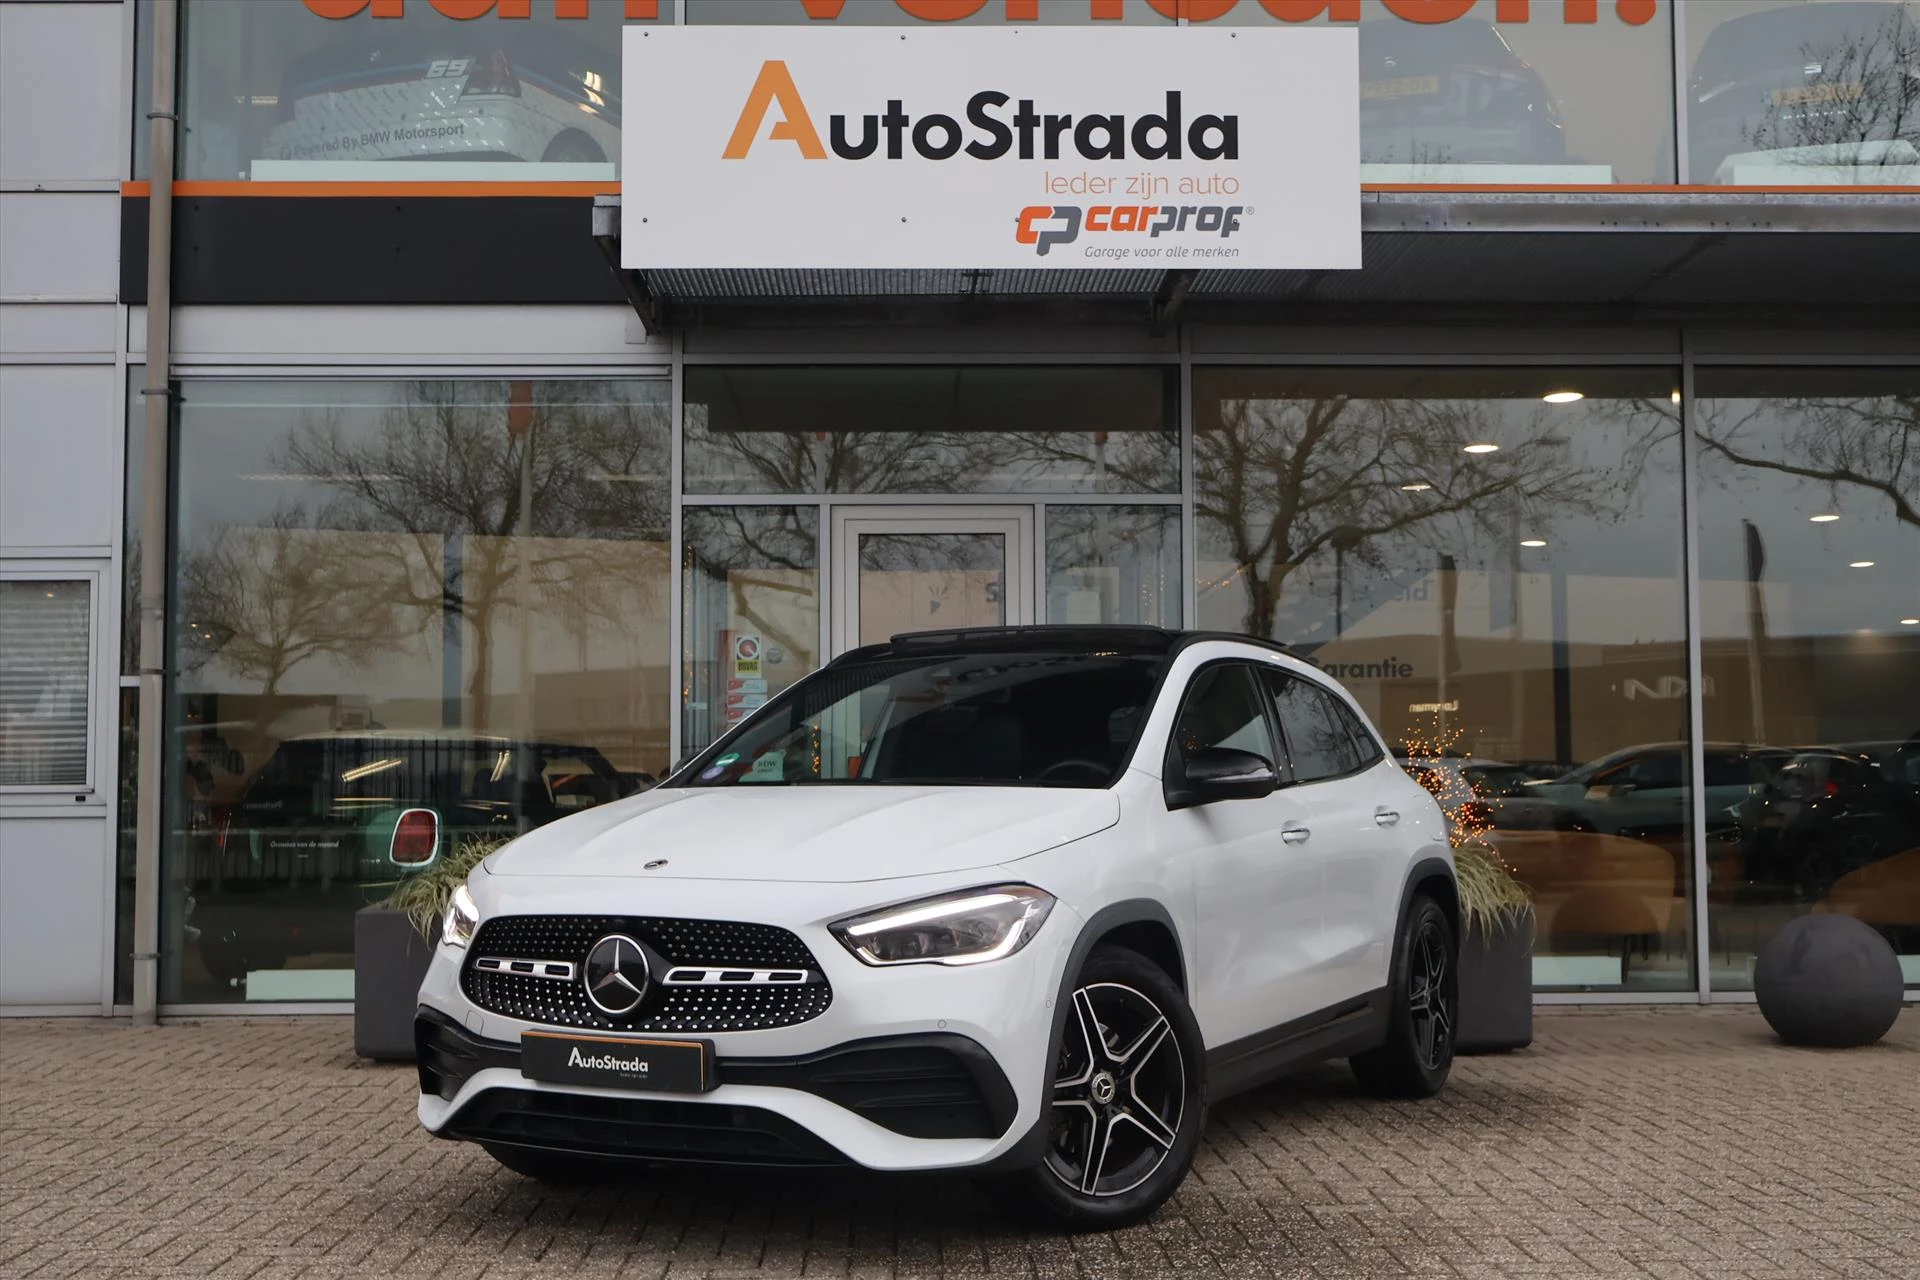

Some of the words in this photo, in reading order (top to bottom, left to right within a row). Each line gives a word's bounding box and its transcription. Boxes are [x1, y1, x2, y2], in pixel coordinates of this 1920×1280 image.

[427, 59, 470, 79] 69
[721, 60, 1240, 160] AutoStrada
[293, 140, 339, 158] Powered
[342, 136, 357, 150] By
[360, 131, 390, 146] BMW
[394, 123, 464, 142] Motorsport
[1045, 171, 1117, 195] Ieder
[1125, 172, 1169, 200] zijn
[1178, 174, 1240, 195] auto
[1084, 246, 1130, 260] Garage
[1134, 247, 1163, 258] voor
[1166, 246, 1189, 258] alle
[1193, 246, 1240, 258] merken
[1315, 657, 1413, 678] arantie
[309, 840, 317, 848] de
[567, 1046, 649, 1073] AutoStrada
